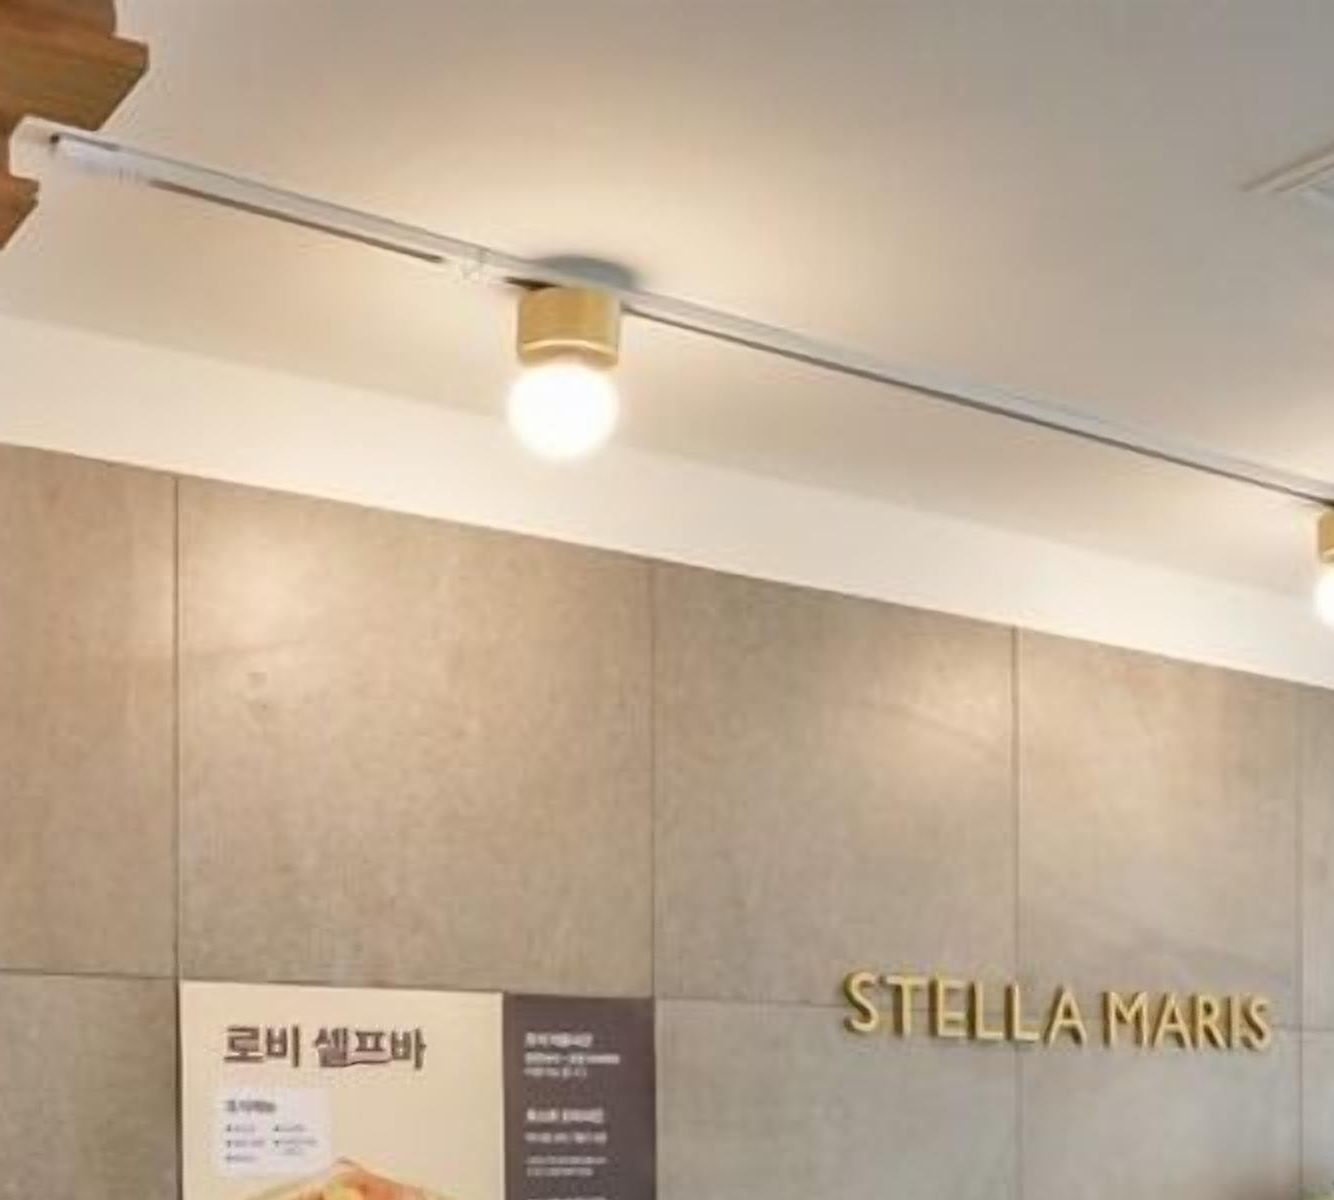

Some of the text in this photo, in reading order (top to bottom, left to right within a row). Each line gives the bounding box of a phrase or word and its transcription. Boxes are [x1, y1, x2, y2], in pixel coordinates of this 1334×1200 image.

[844, 971, 1272, 1049] STELLA MARIS
[223, 1024, 427, 1069] 로비 셀프바
